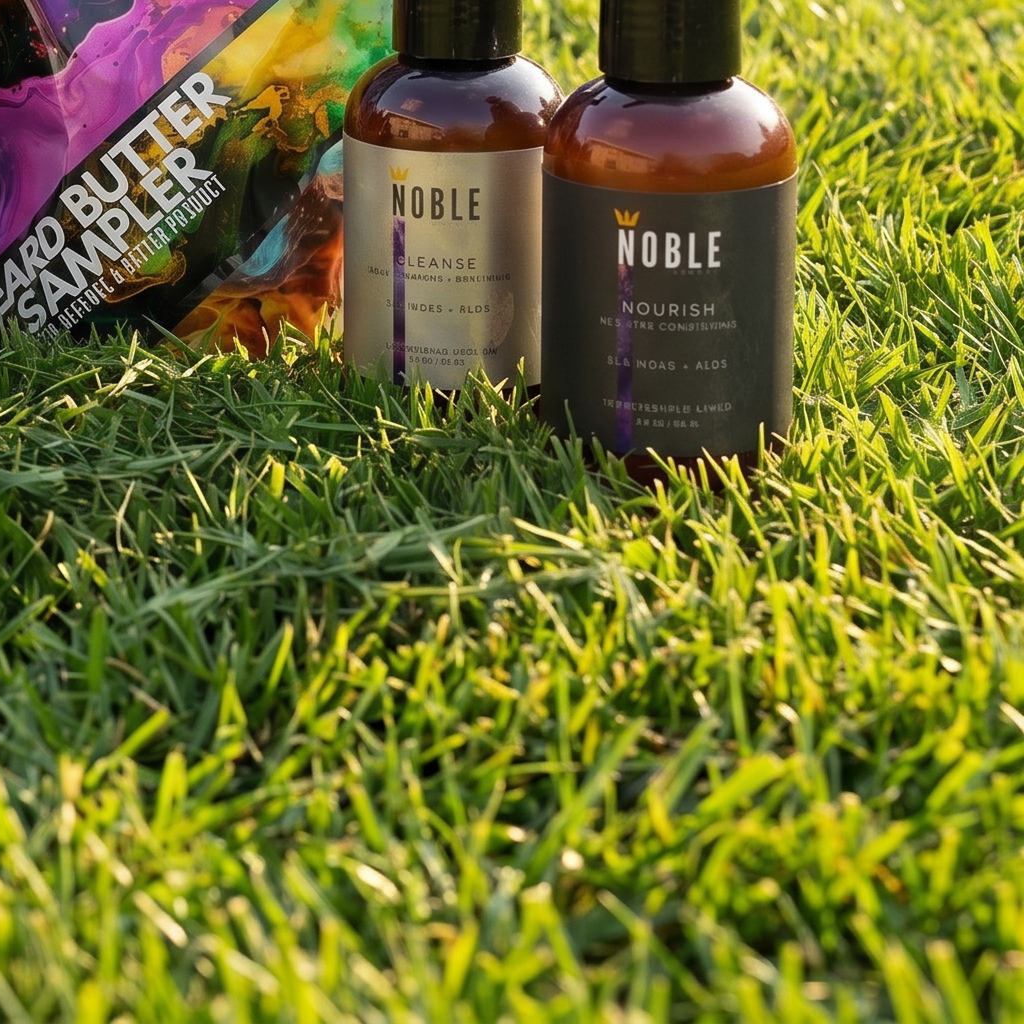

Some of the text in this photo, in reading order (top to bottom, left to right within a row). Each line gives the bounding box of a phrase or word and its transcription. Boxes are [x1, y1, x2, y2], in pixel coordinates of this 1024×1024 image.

[59, 72, 232, 229] BUTTER
[392, 183, 481, 221] NOBLE
[17, 147, 214, 334] SAMPLER
[617, 228, 722, 269] NOBLE
[396, 255, 477, 270] CLEANSE
[622, 300, 716, 318] NOURISH
